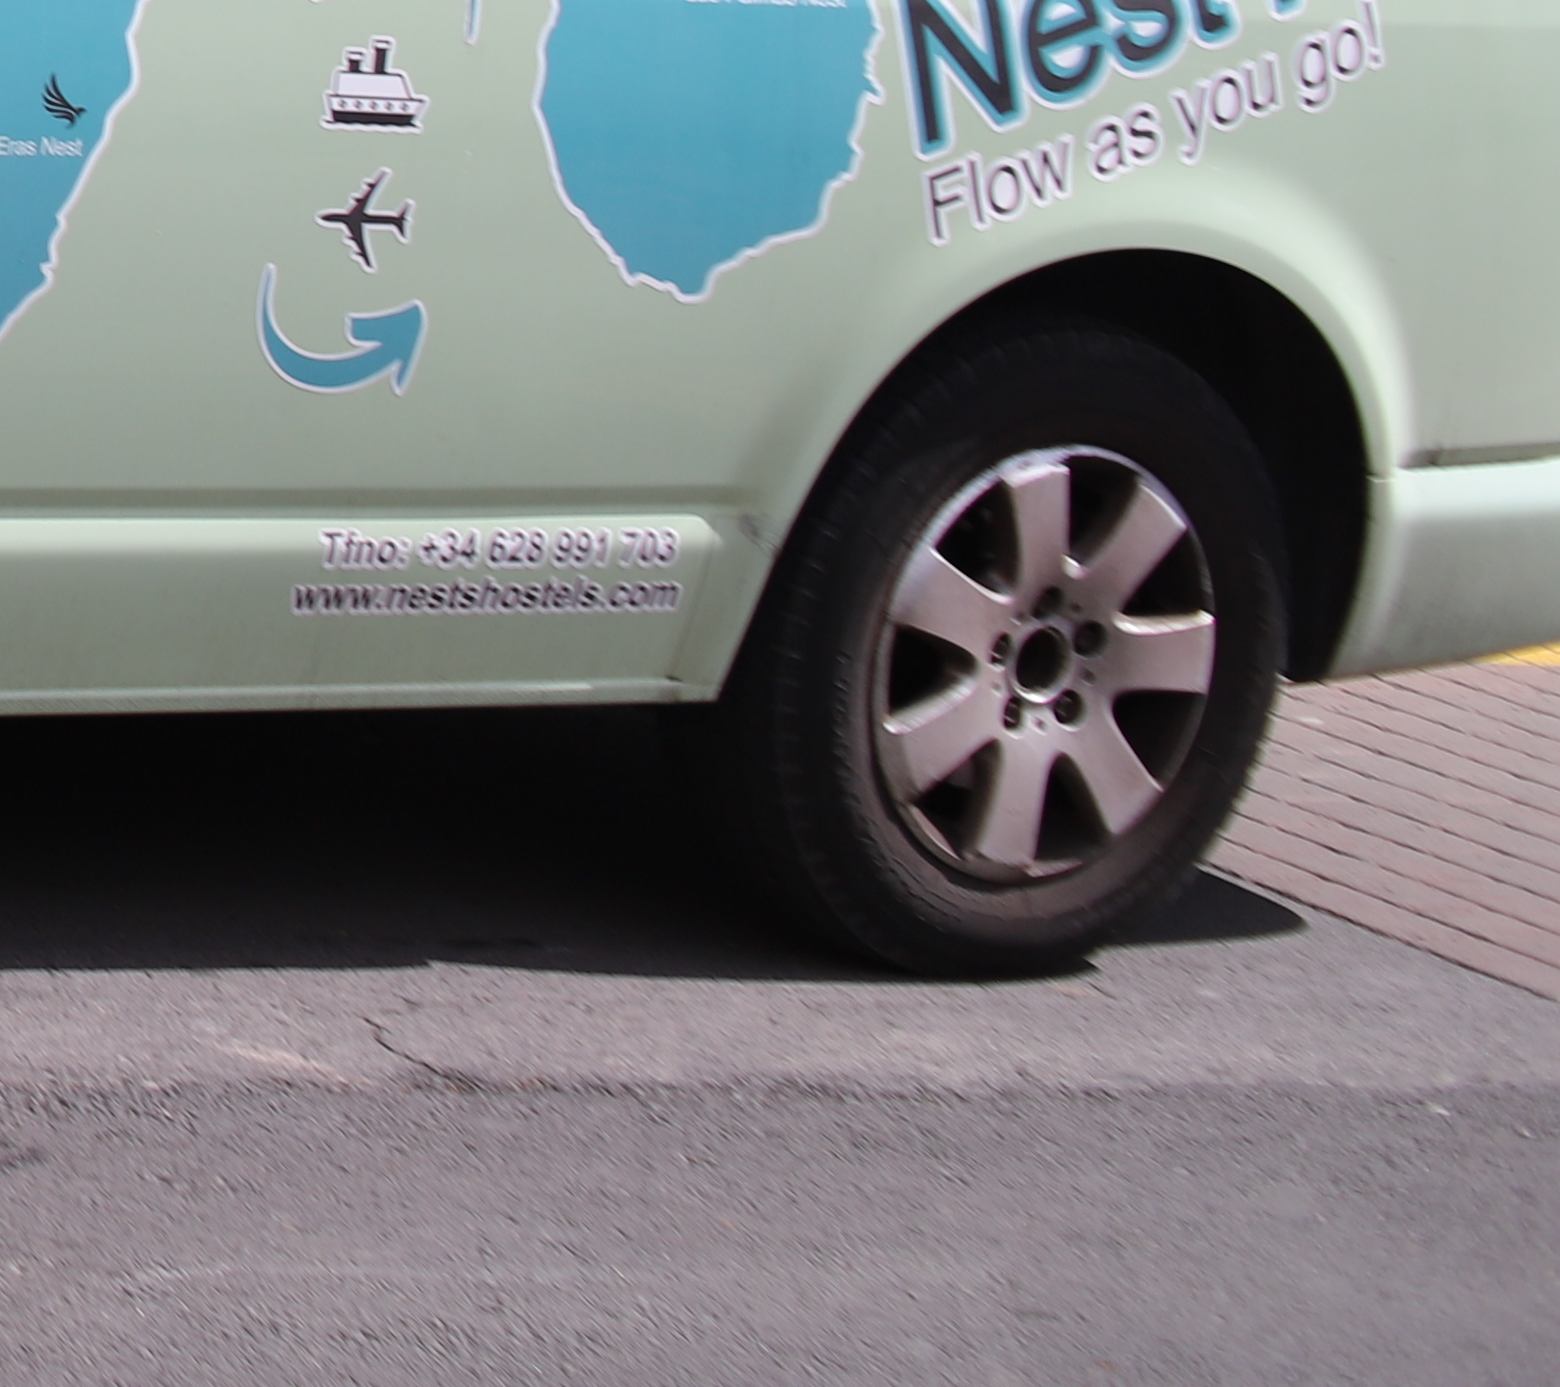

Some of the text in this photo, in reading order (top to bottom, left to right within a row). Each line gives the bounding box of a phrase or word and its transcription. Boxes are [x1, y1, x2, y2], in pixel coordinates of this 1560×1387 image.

[40, 135, 83, 157] Nest
[926, 135, 1072, 242] Flow
[1088, 105, 1162, 177] as
[1170, 49, 1280, 163] you
[320, 527, 679, 569] Tfno: +34 628 991 703
[291, 575, 683, 615] www.nestshostels.com
